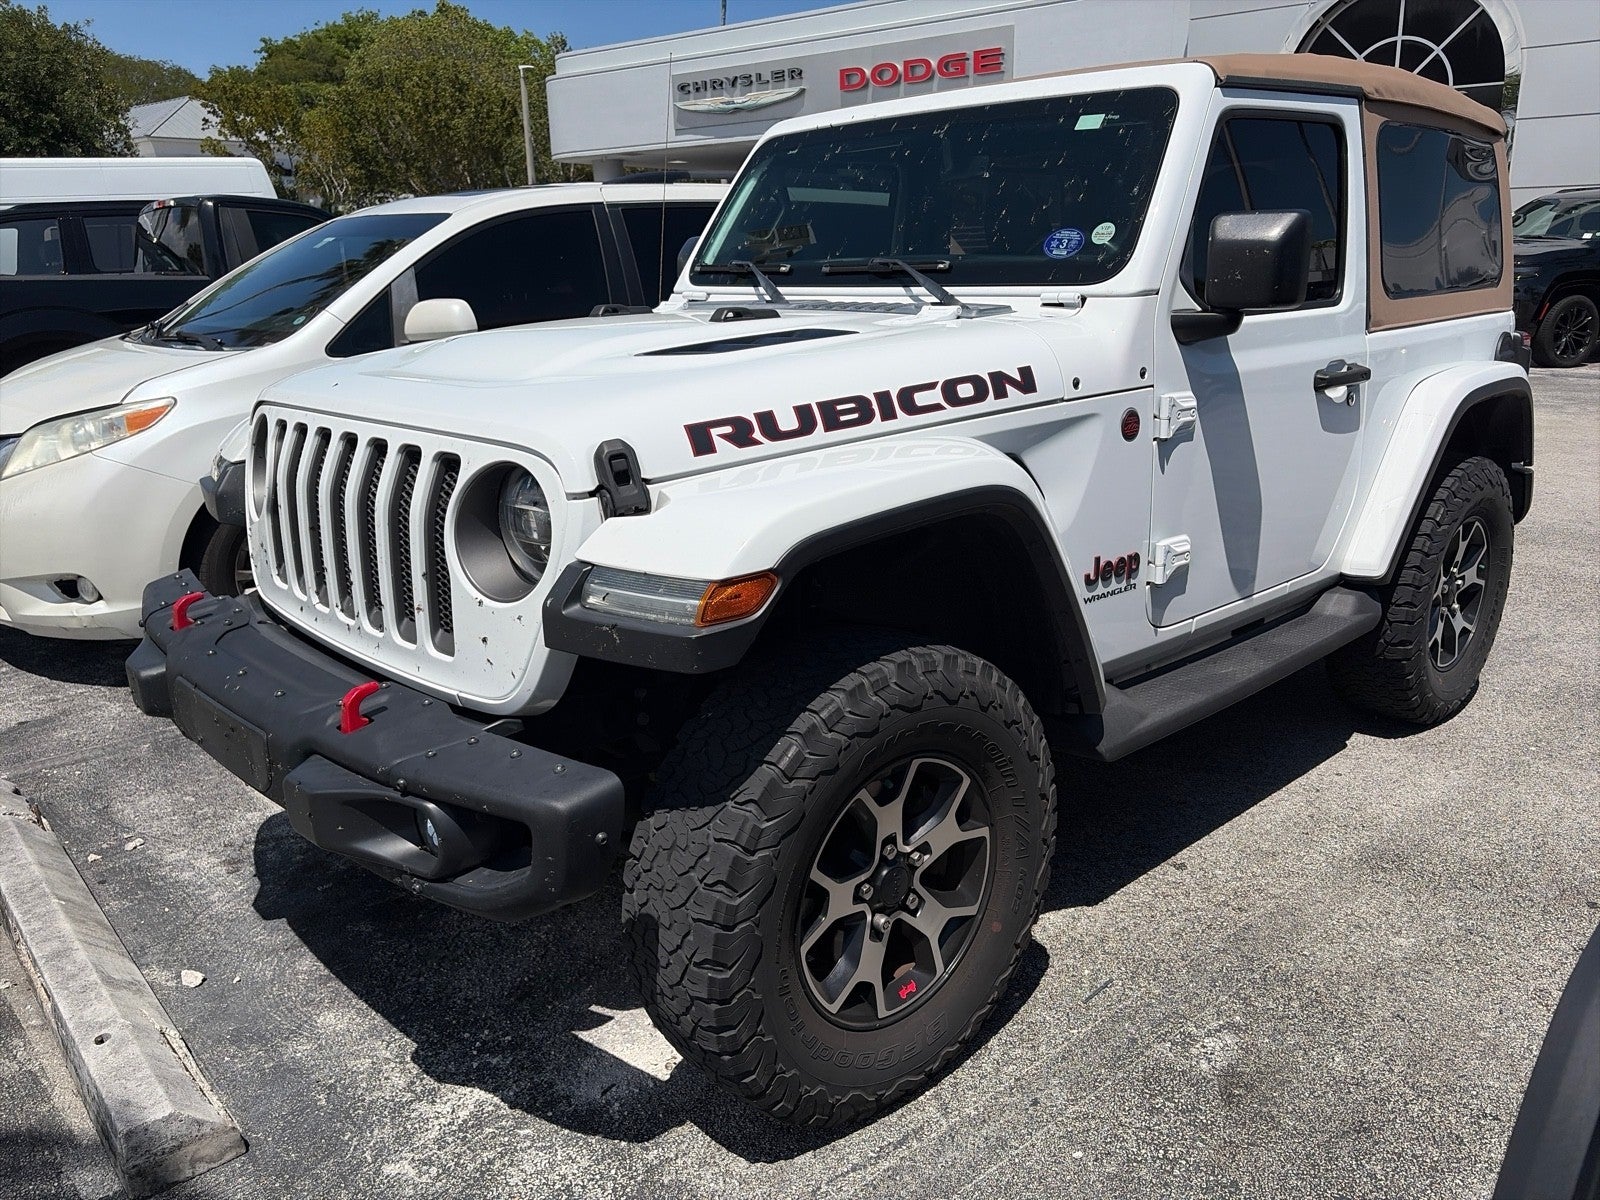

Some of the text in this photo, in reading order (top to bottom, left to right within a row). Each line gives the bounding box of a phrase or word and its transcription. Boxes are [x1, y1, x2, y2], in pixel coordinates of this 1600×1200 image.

[676, 67, 804, 95] CHRYSLER
[839, 46, 1006, 92] DODGE
[1059, 239, 1068, 249] 3
[684, 365, 1038, 458] RUBICON
[1084, 552, 1141, 588] Jeep
[1083, 583, 1137, 605] WRANGLER
[776, 966, 949, 1071] BFGoodrich
